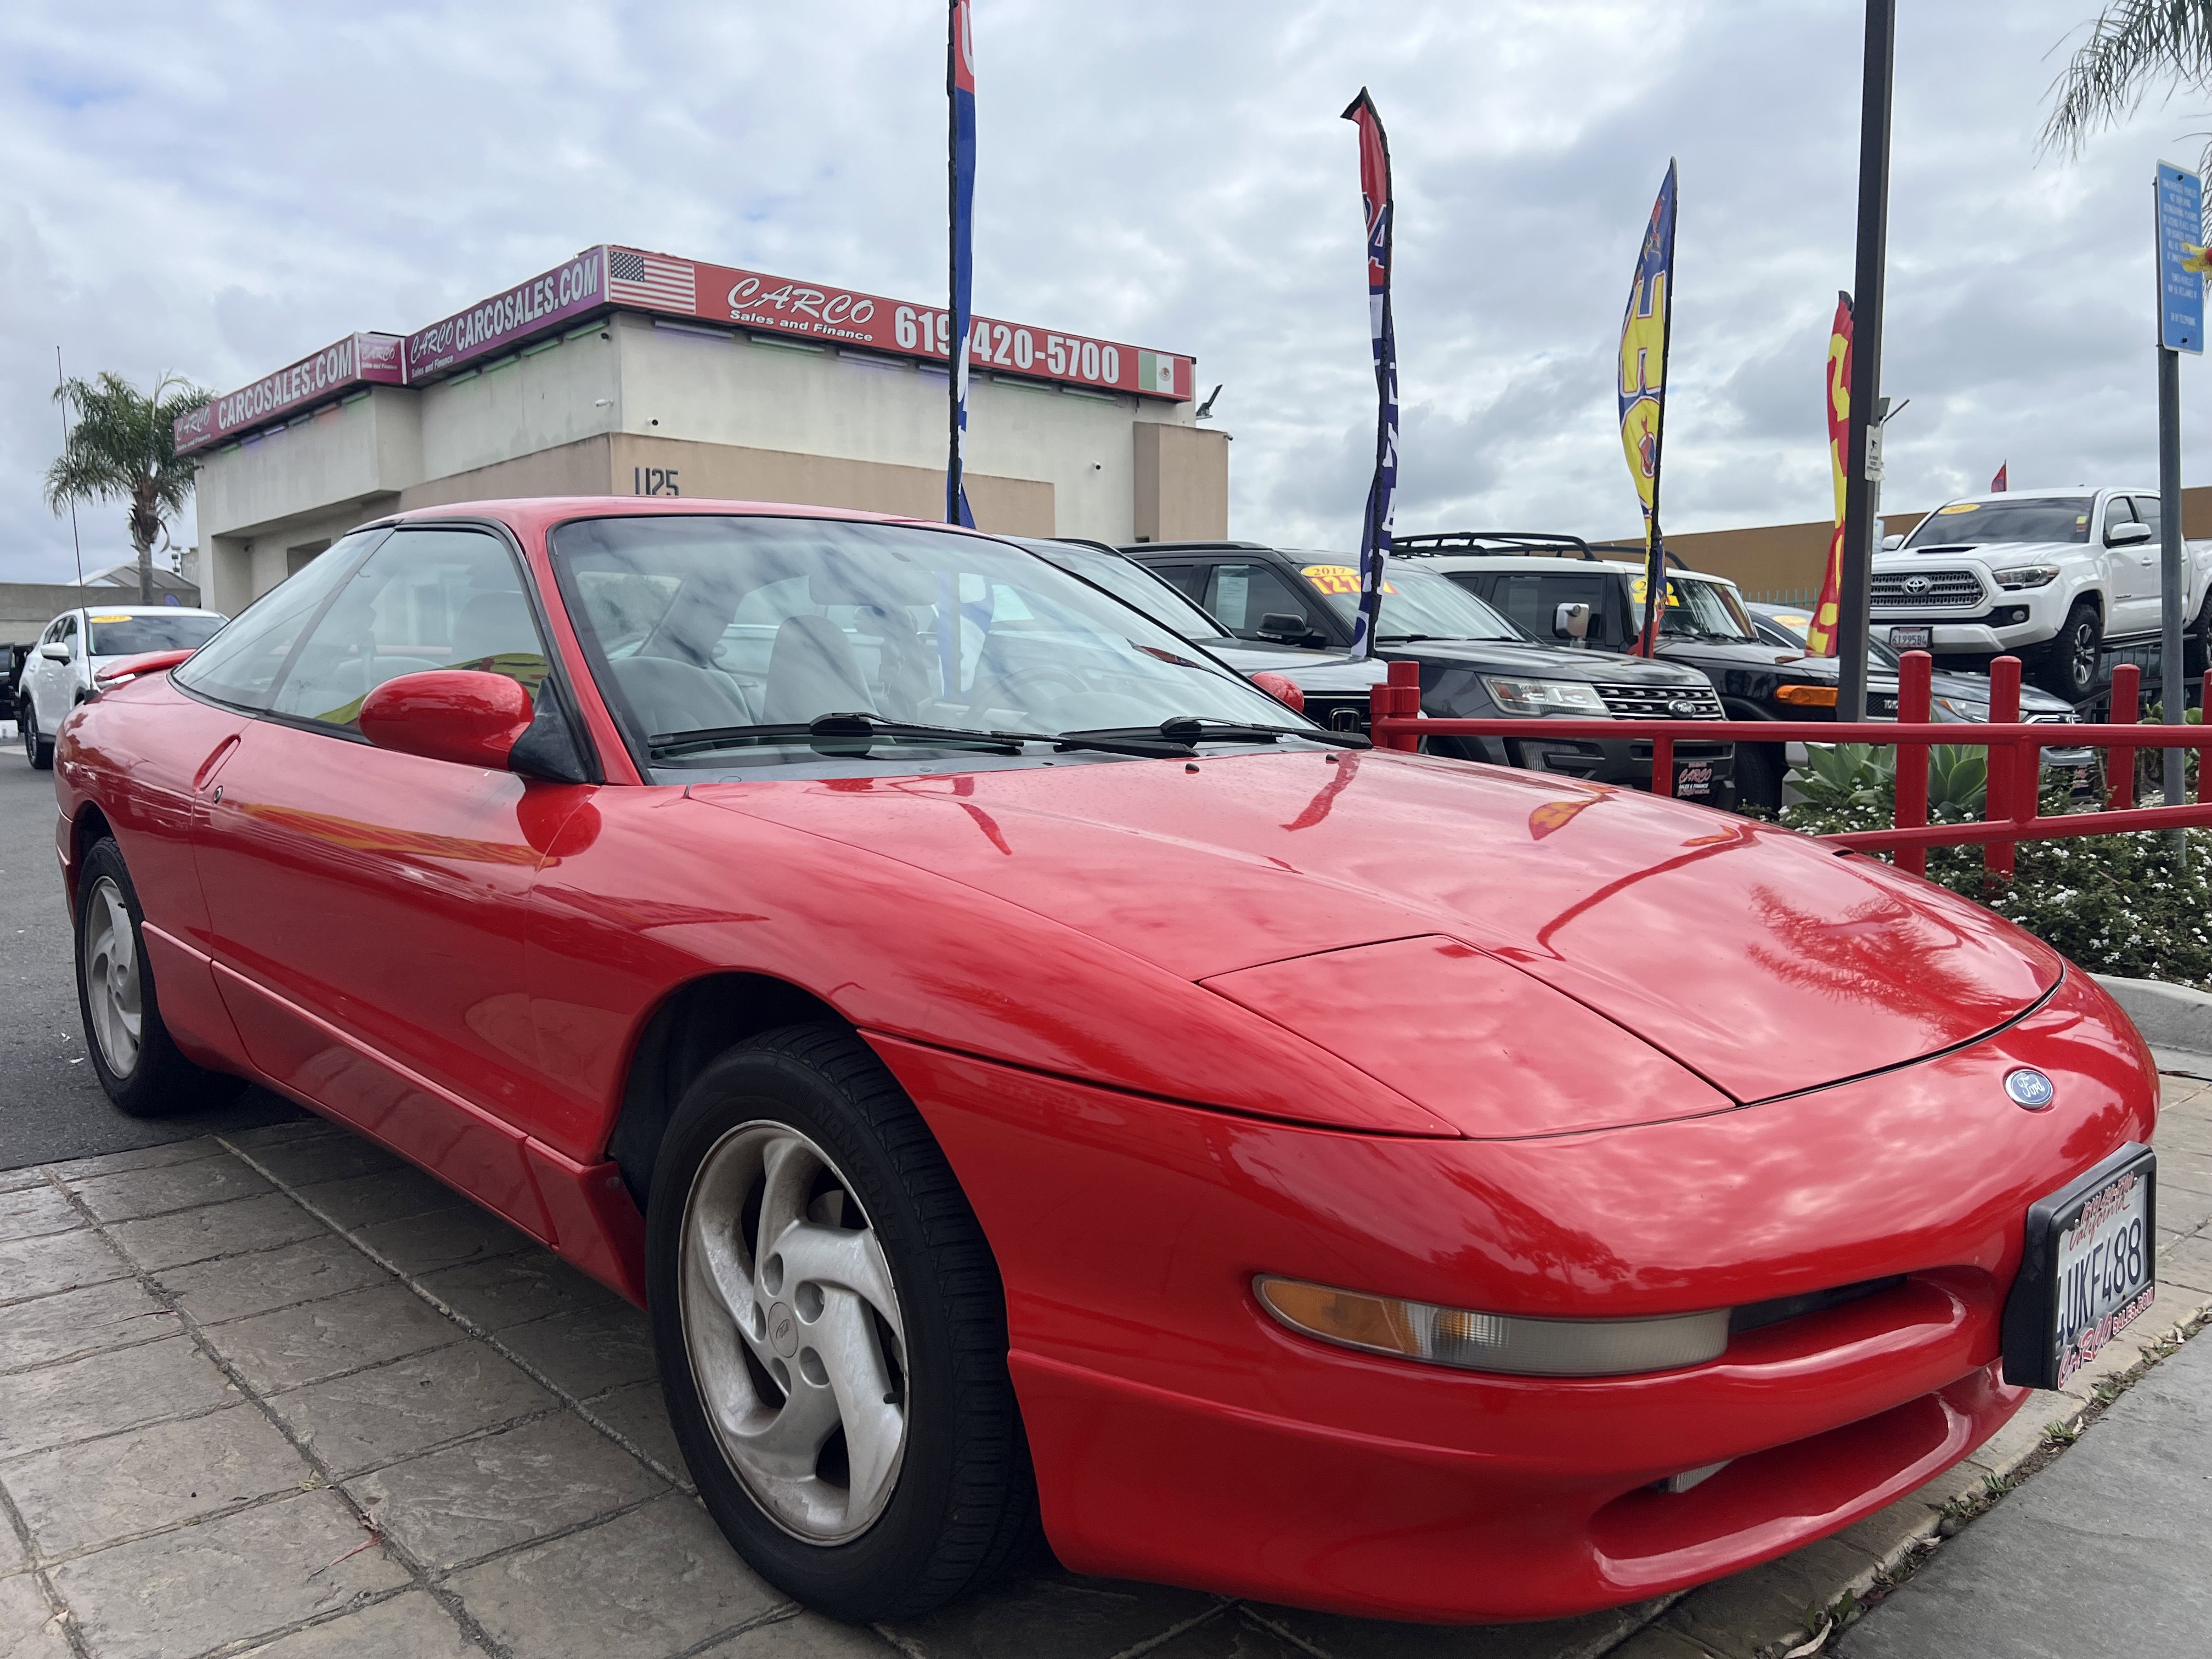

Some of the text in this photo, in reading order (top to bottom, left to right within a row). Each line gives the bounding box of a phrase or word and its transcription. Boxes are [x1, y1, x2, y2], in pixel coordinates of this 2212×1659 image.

[411, 254, 599, 365] CARCO CARCOSALES.COM
[727, 277, 874, 325] CARCO
[730, 309, 873, 342] Sales and Finance
[895, 306, 1119, 385] 619420-5700
[177, 340, 352, 442] CARCO CARCOSALES.COM
[411, 355, 454, 379] Sales and Finance
[634, 467, 679, 496] 1125
[1313, 567, 1347, 575] 2017
[2017, 1076, 2045, 1098] Ford
[2069, 1194, 2130, 1251] California
[2056, 1217, 2141, 1346] 4UKF488
